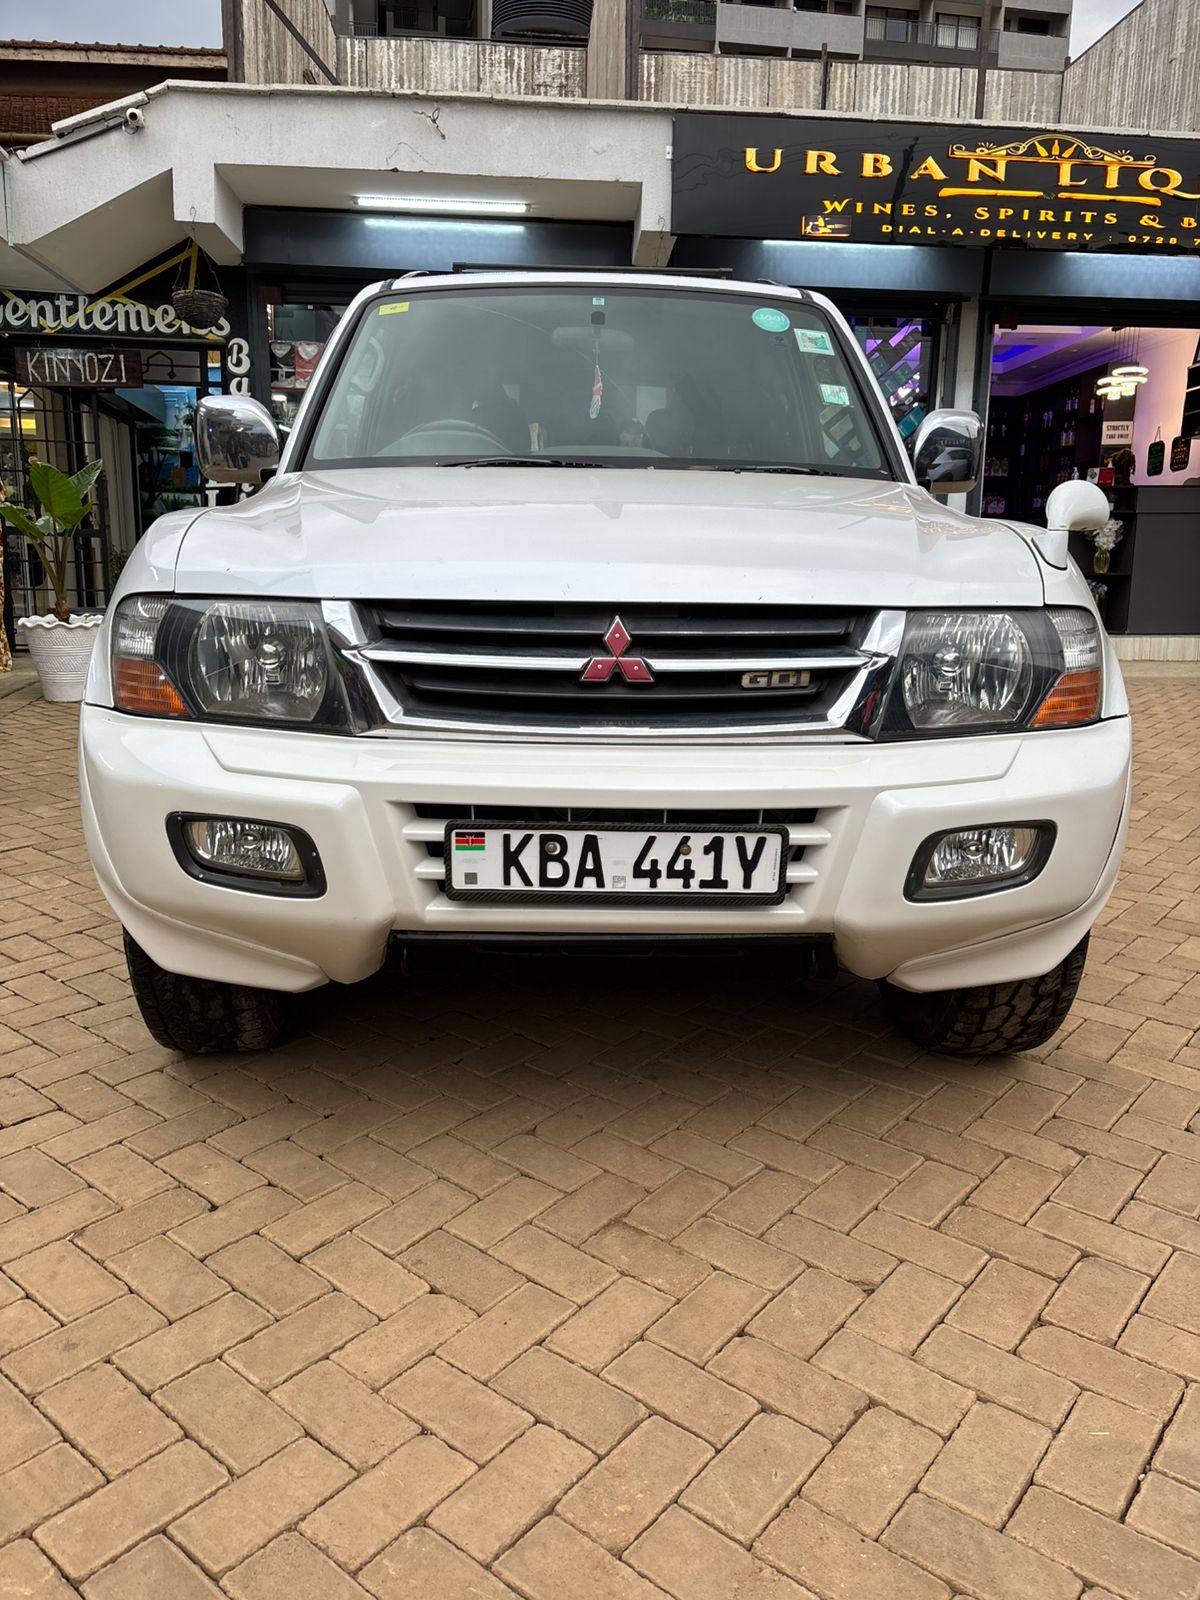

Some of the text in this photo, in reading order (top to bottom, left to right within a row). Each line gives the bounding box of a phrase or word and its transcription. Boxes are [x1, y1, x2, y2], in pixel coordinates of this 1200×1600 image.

[744, 147, 1009, 184] URBAN
[822, 198, 952, 219] WINES,
[974, 206, 1118, 225] SPIRITS
[1139, 214, 1166, 229] &
[1128, 235, 1177, 245] 0728
[0, 293, 231, 336] entlemes
[26, 351, 128, 383] KINYOZI
[741, 670, 811, 689] GDI
[503, 833, 606, 889] KBA
[633, 835, 768, 890] 441Y
